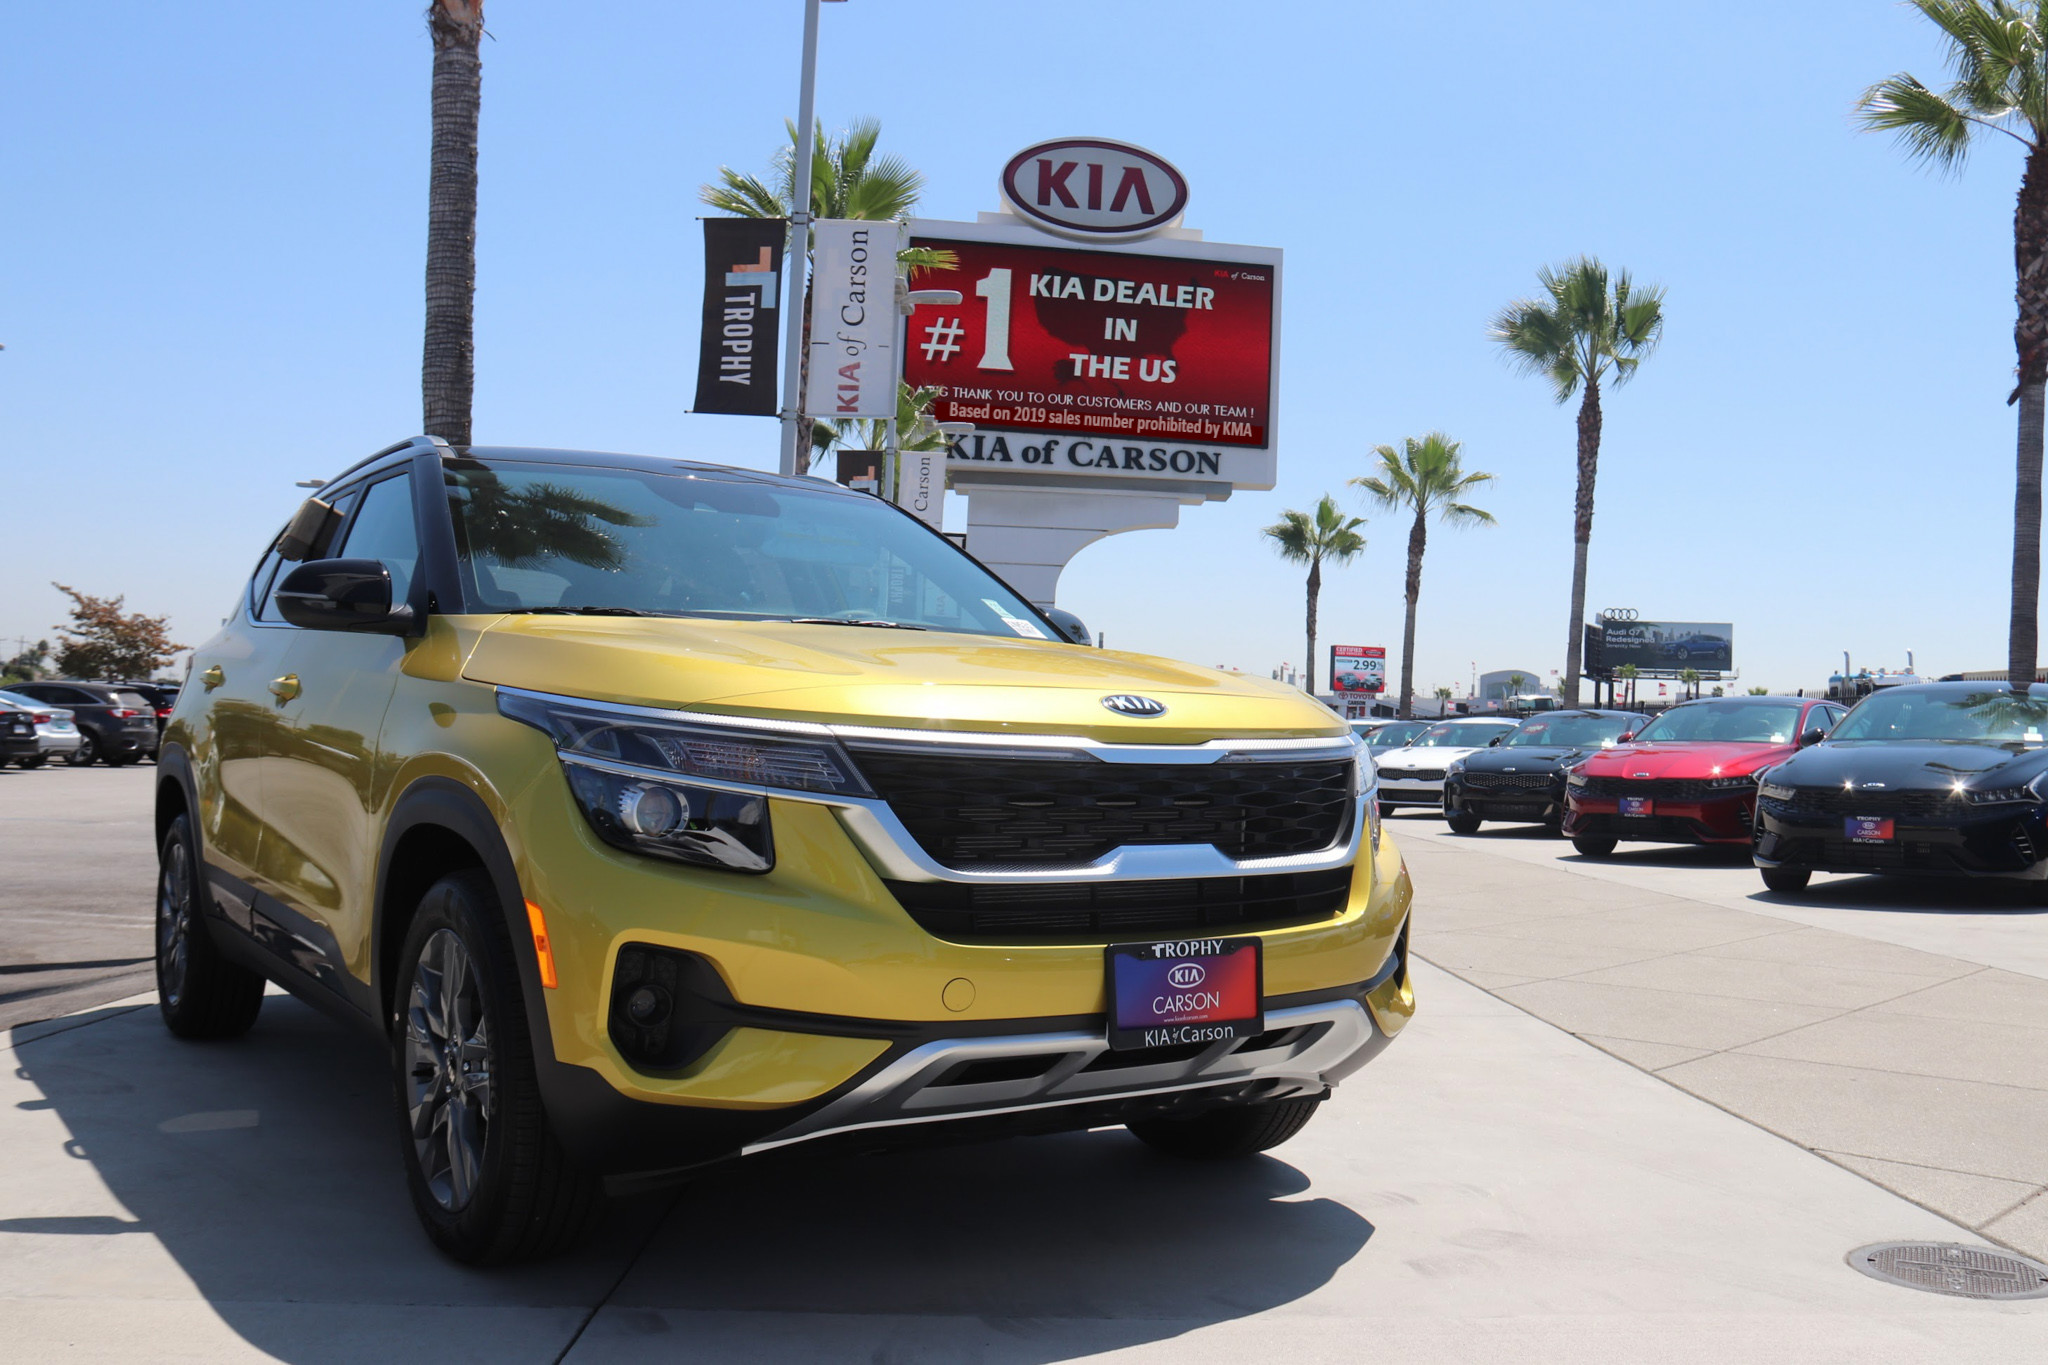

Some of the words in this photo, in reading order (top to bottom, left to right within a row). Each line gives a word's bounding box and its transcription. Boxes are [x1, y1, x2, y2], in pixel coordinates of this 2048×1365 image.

[1036, 158, 1155, 215] KIA
[841, 229, 869, 326] Carson
[1214, 270, 1229, 278] KIA
[1231, 272, 1239, 280] of
[1241, 272, 1265, 281] Carson
[1029, 273, 1085, 300] KIA
[1093, 278, 1215, 310] DEALER
[719, 292, 755, 385] TROPHY
[836, 331, 867, 356] of
[1104, 317, 1138, 342] IN
[1069, 353, 1131, 380] THE
[1139, 358, 1177, 384] US
[836, 361, 861, 412] KIA
[953, 386, 992, 400] THANK
[997, 390, 1024, 402] YOU
[1027, 391, 1045, 404] TO
[1047, 394, 1074, 406] OUR
[1077, 395, 1152, 411] CUSTOMERS
[1155, 401, 1182, 413] AND
[1184, 402, 1210, 415] OUR
[1213, 404, 1247, 418] TEAM
[949, 401, 990, 419] Based
[993, 408, 1010, 421] on
[1013, 406, 1046, 423] 2019
[1048, 409, 1081, 426] sales
[1083, 412, 1133, 429] number
[1136, 416, 1201, 433] prohibited
[1204, 419, 1220, 438] by
[1222, 421, 1253, 437] KMA
[946, 433, 1013, 462] KIA
[1021, 440, 1059, 464] of
[1067, 441, 1222, 475] CARSON
[914, 457, 931, 511] Carson
[1605, 635, 1656, 644] Redesigned
[1109, 695, 1162, 711] KIA
[1151, 939, 1223, 959] TROPHY
[1174, 968, 1200, 983] KIA
[1152, 991, 1219, 1015] CARSON
[1145, 1028, 1171, 1047] KIA
[1180, 1025, 1234, 1043] Carson
